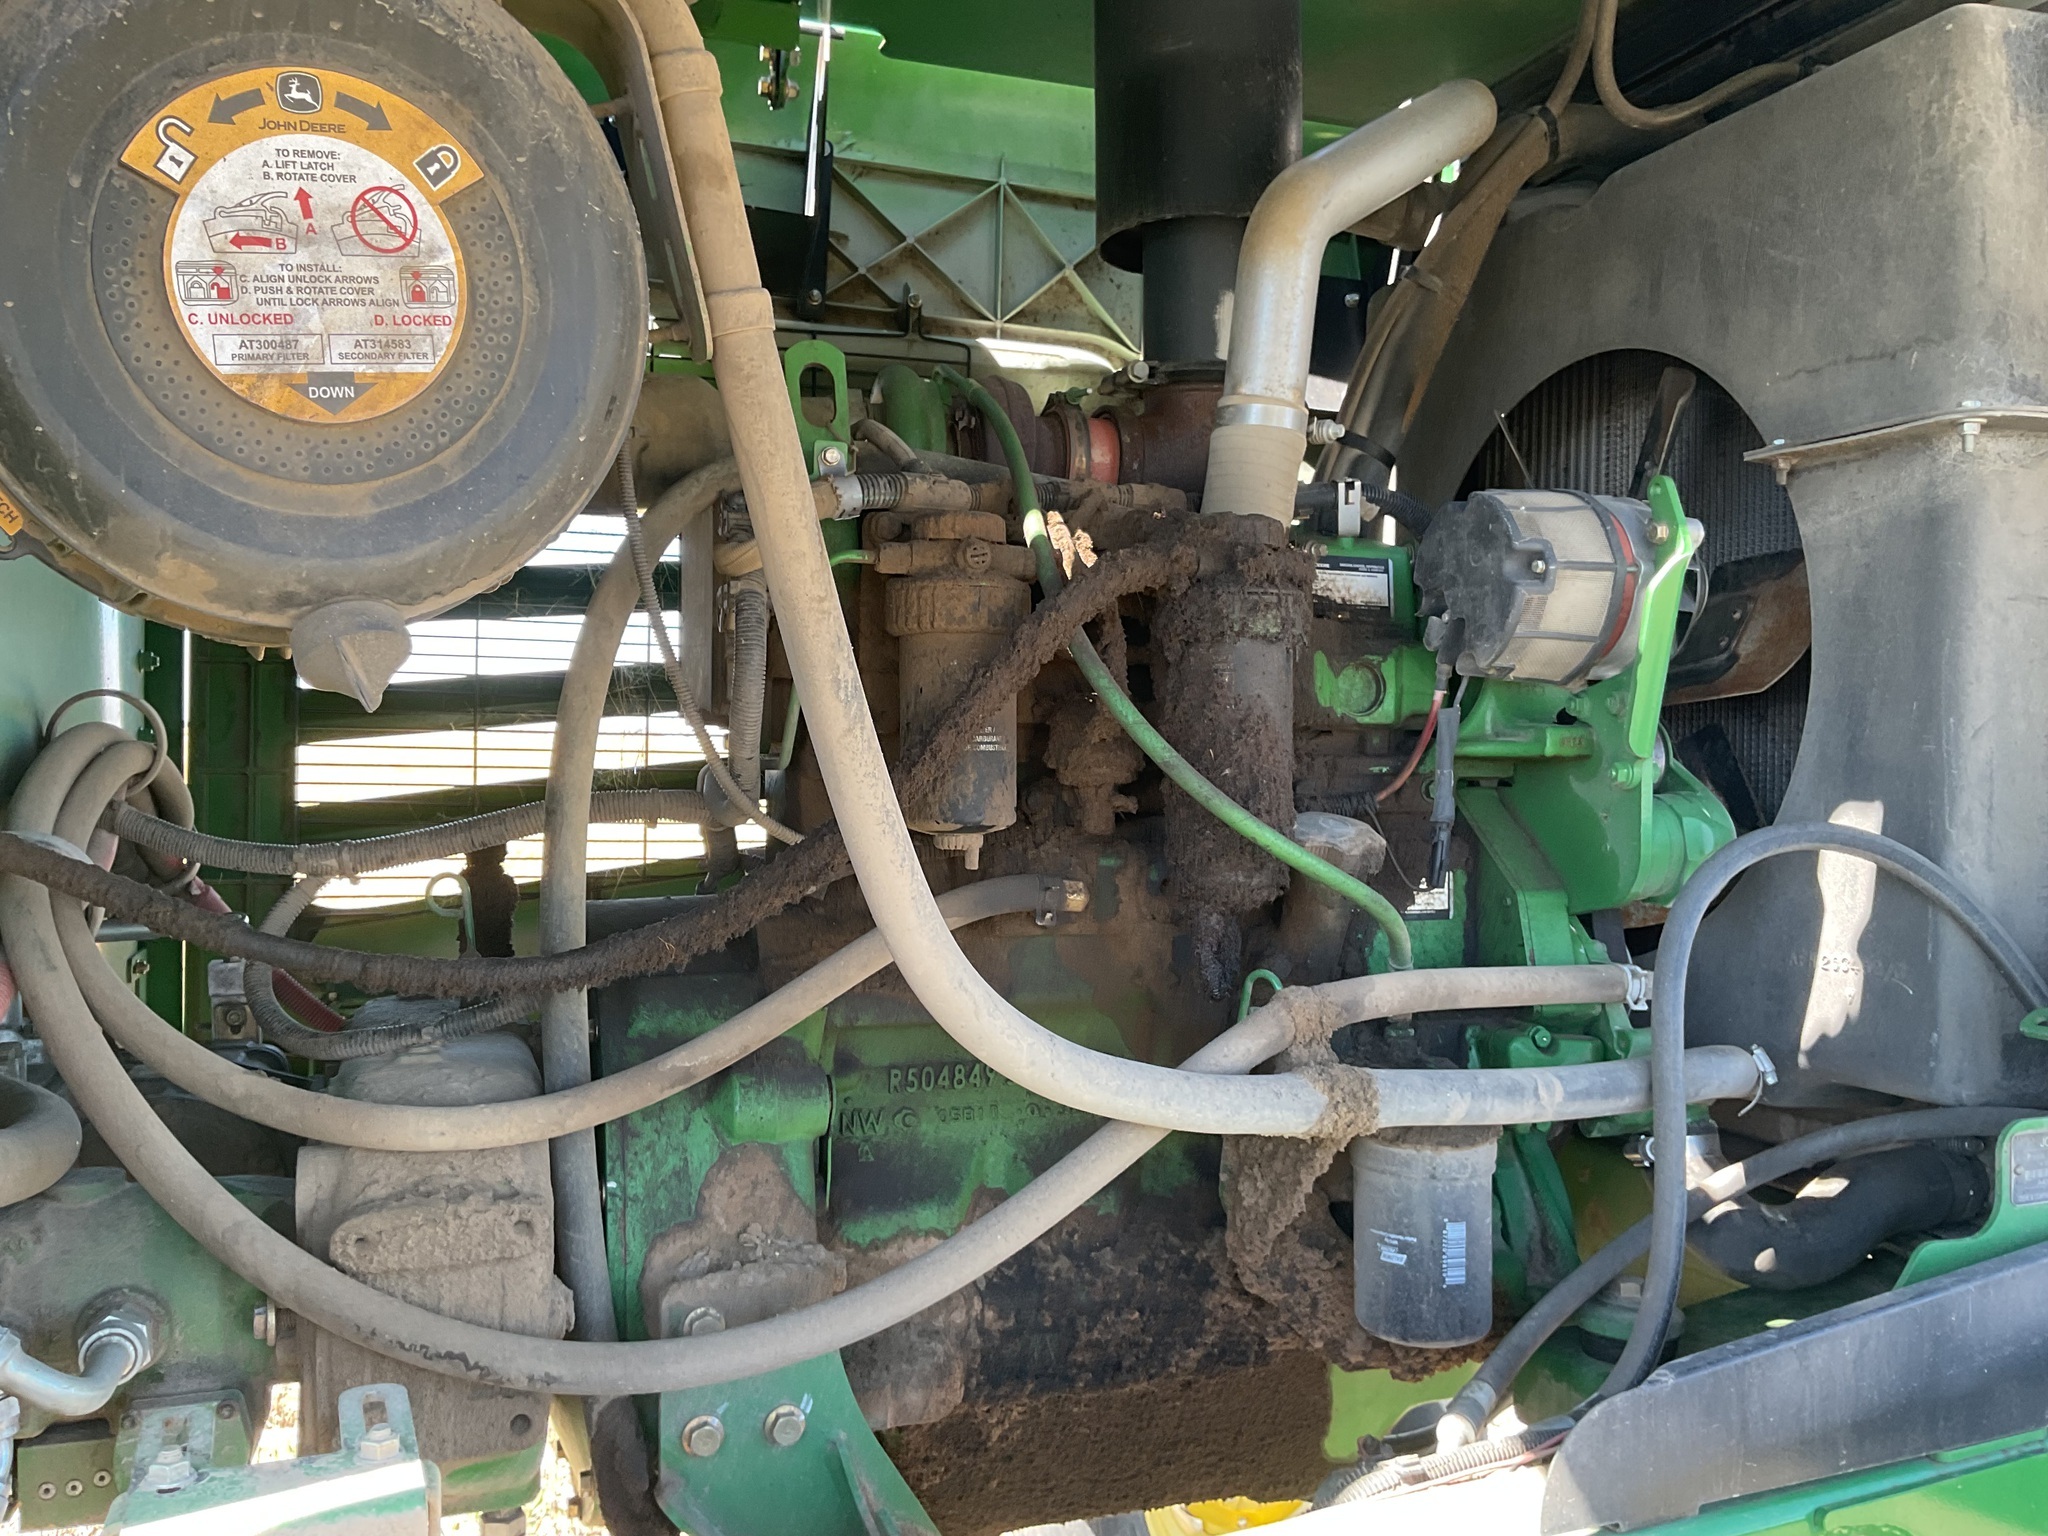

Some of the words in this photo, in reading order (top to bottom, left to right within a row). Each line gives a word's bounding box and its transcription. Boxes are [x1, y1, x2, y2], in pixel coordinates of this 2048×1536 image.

[258, 118, 298, 132] JOHN
[299, 119, 347, 134] DEERE
[275, 148, 290, 158] TO
[292, 149, 341, 160] REMOVE:
[262, 159, 273, 169] A.
[275, 160, 297, 170] LIFT
[300, 161, 335, 171] LATCH
[263, 171, 274, 181] B.
[276, 172, 318, 182] ROTATE
[320, 173, 358, 184] COVER
[305, 222, 318, 236] A
[275, 237, 287, 250] B
[279, 263, 294, 272] TO
[296, 263, 342, 273] INSTALL:
[239, 274, 250, 283] C.
[252, 274, 286, 284] ALIGN
[287, 275, 332, 284] UNLOCK
[332, 275, 380, 285] ARROWS
[240, 286, 251, 295] D.
[254, 286, 284, 295] PUSH
[285, 286, 294, 295] &
[296, 286, 337, 296] ROTATE
[339, 286, 375, 296] COVER
[256, 297, 288, 307] UNTIL
[290, 297, 320, 307] LOCK
[321, 298, 367, 307] ARROWS
[368, 298, 400, 308] ALIGN
[187, 312, 204, 325] C.
[207, 312, 295, 326] UNLOCKED
[374, 314, 389, 327] D.
[392, 314, 453, 327] LOCKED
[238, 339, 300, 351] AT300487
[353, 338, 412, 350] AT314583
[231, 352, 275, 361] PRIMARY
[277, 352, 310, 361] FILTER
[338, 352, 396, 361] SECONDARY
[398, 352, 429, 361] FILTER
[308, 385, 355, 400] DOWN
[0, 497, 19, 524] CH
